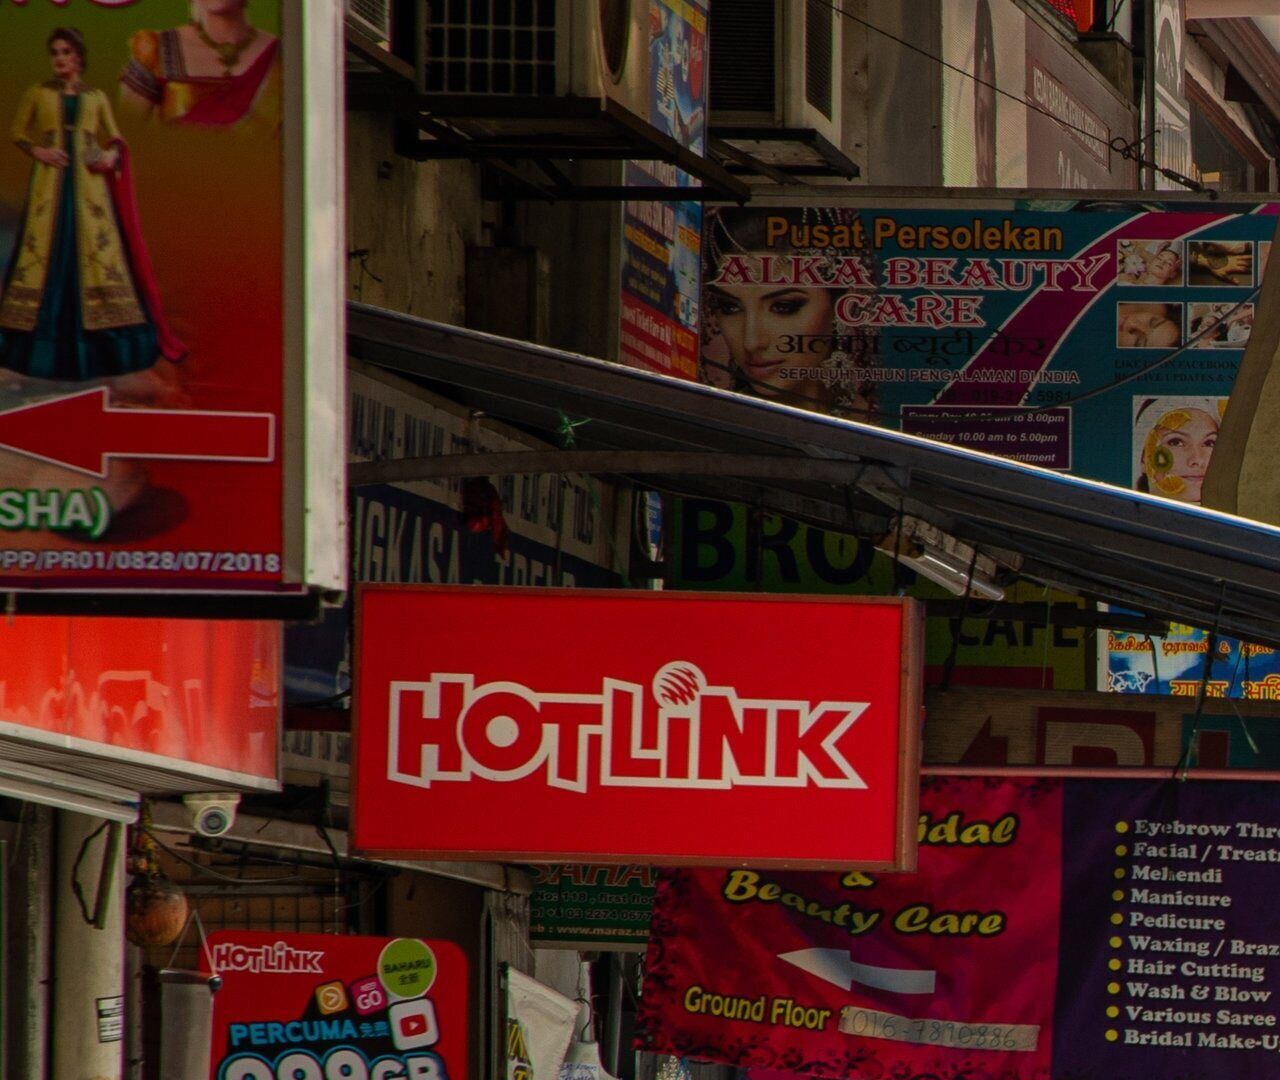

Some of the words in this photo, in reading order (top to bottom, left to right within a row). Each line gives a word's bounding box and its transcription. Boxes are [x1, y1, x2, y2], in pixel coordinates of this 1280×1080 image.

[766, 216, 864, 250] Pusat
[873, 217, 1064, 250] Persolekan
[706, 254, 878, 289] ALKA
[883, 254, 1111, 292] BEAUTY
[835, 294, 987, 329] CARE
[779, 368, 851, 381] SEPULUH
[855, 369, 905, 381] TAHUN
[909, 369, 1018, 383] PENGALAMAN
[1038, 370, 1081, 384] INDIA
[1134, 820, 1231, 837] Eyebrow
[1133, 842, 1197, 860] Facial
[724, 868, 881, 936] Beauty
[894, 903, 1006, 936] Care
[1130, 888, 1232, 907] Manicure
[1129, 912, 1226, 931] Pedicure
[1129, 935, 1210, 956] Waxing
[1127, 959, 1176, 975] Hair
[1180, 961, 1265, 982] Cutting
[356, 990, 383, 1010] GO
[1126, 982, 1185, 1000] Wash
[1190, 985, 1208, 1000] &
[1215, 986, 1271, 1002] Blow
[684, 984, 765, 1024] Ground
[770, 998, 831, 1032] Floor
[1126, 1005, 1211, 1024] Various
[1216, 1009, 1277, 1027] Saree
[230, 1019, 359, 1046] PERCUMA
[1124, 1029, 1192, 1047] Bridal
